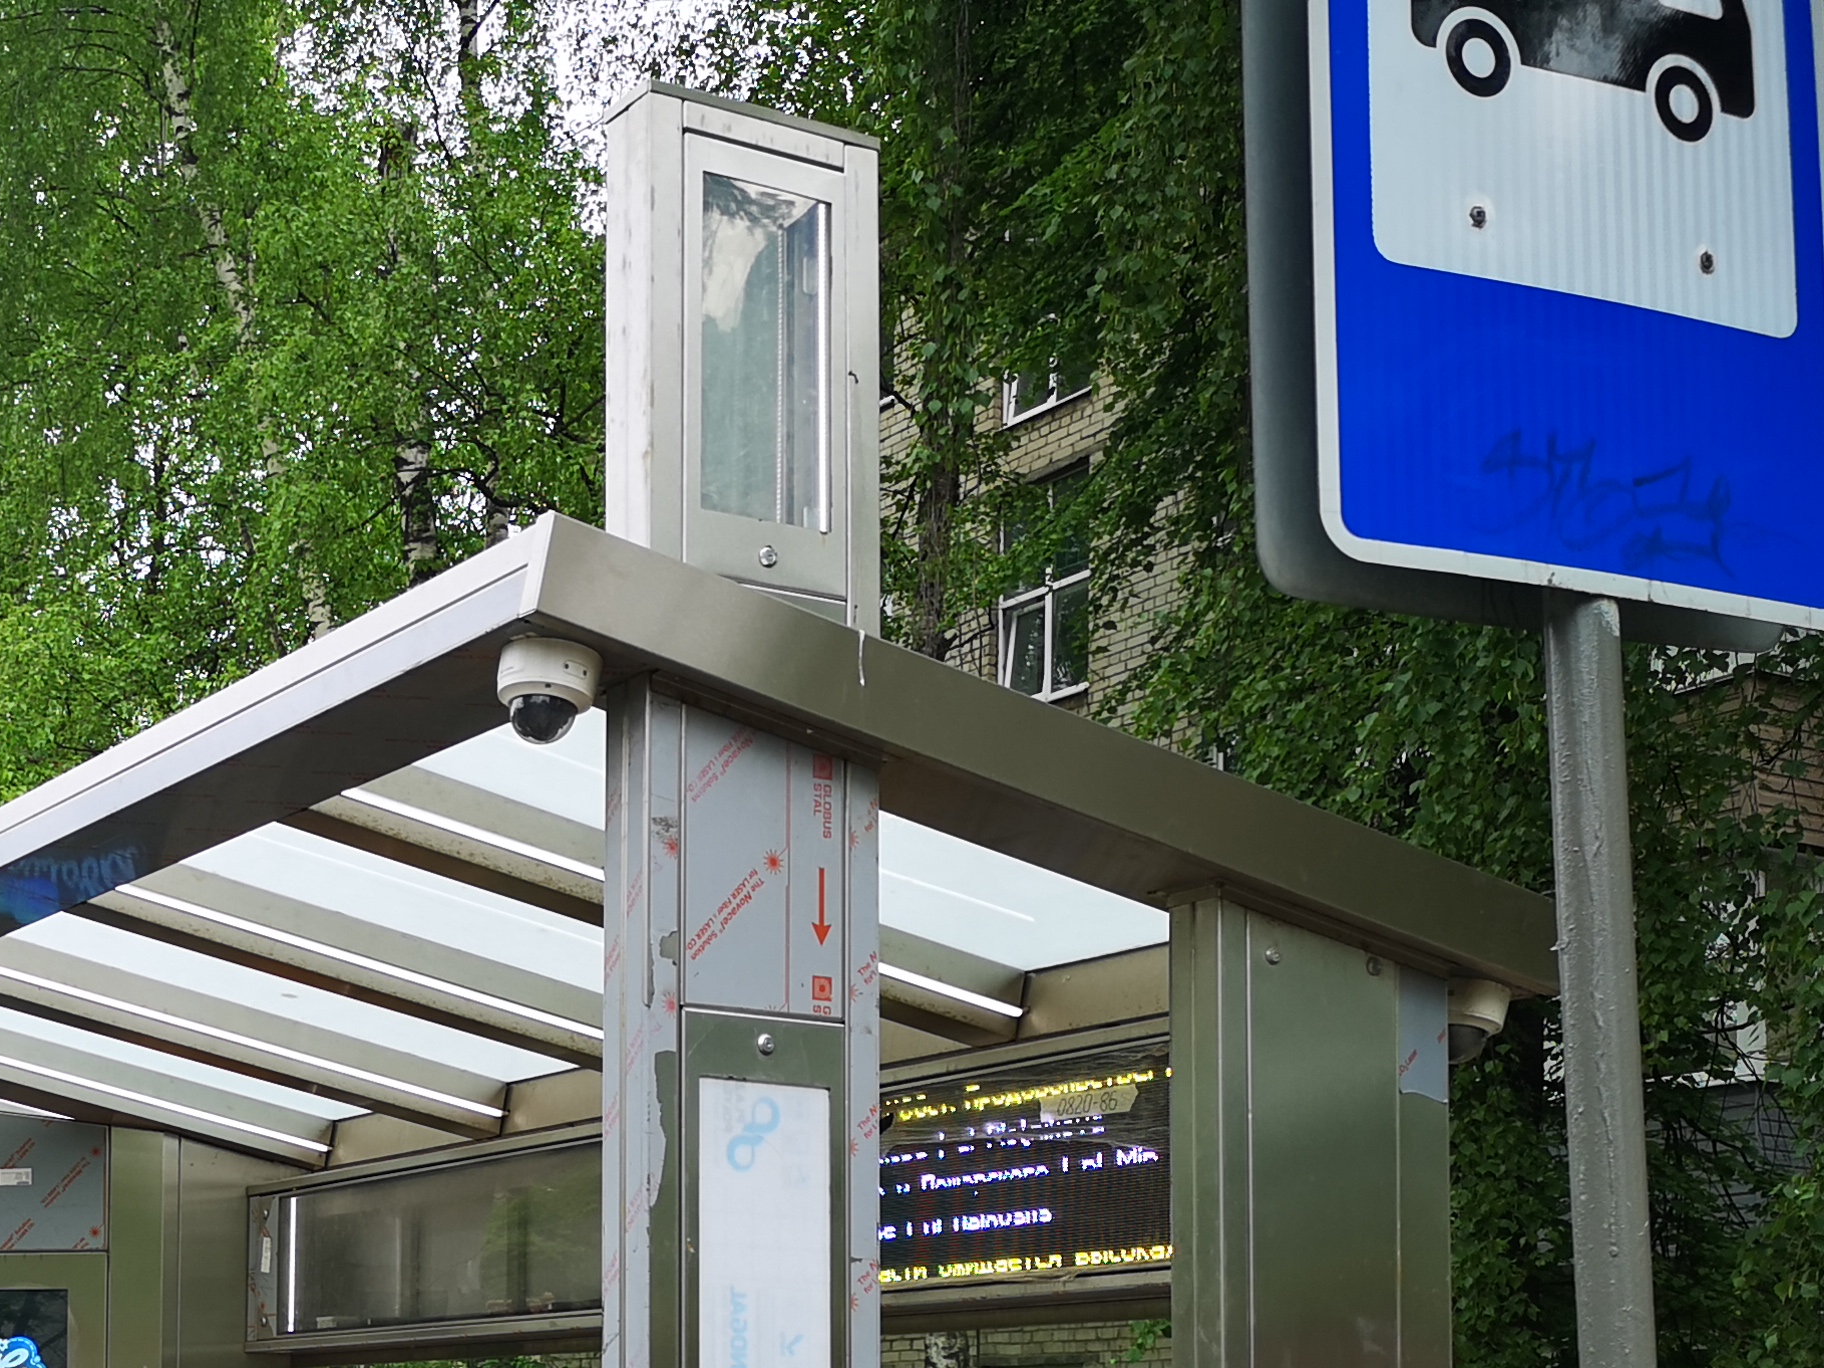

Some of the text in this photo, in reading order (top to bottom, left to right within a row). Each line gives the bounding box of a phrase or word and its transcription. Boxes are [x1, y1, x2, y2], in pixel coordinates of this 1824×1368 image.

[813, 783, 822, 816] STAL
[823, 784, 832, 839] GLOBUS
[750, 878, 765, 893] The
[690, 930, 718, 961] Solution
